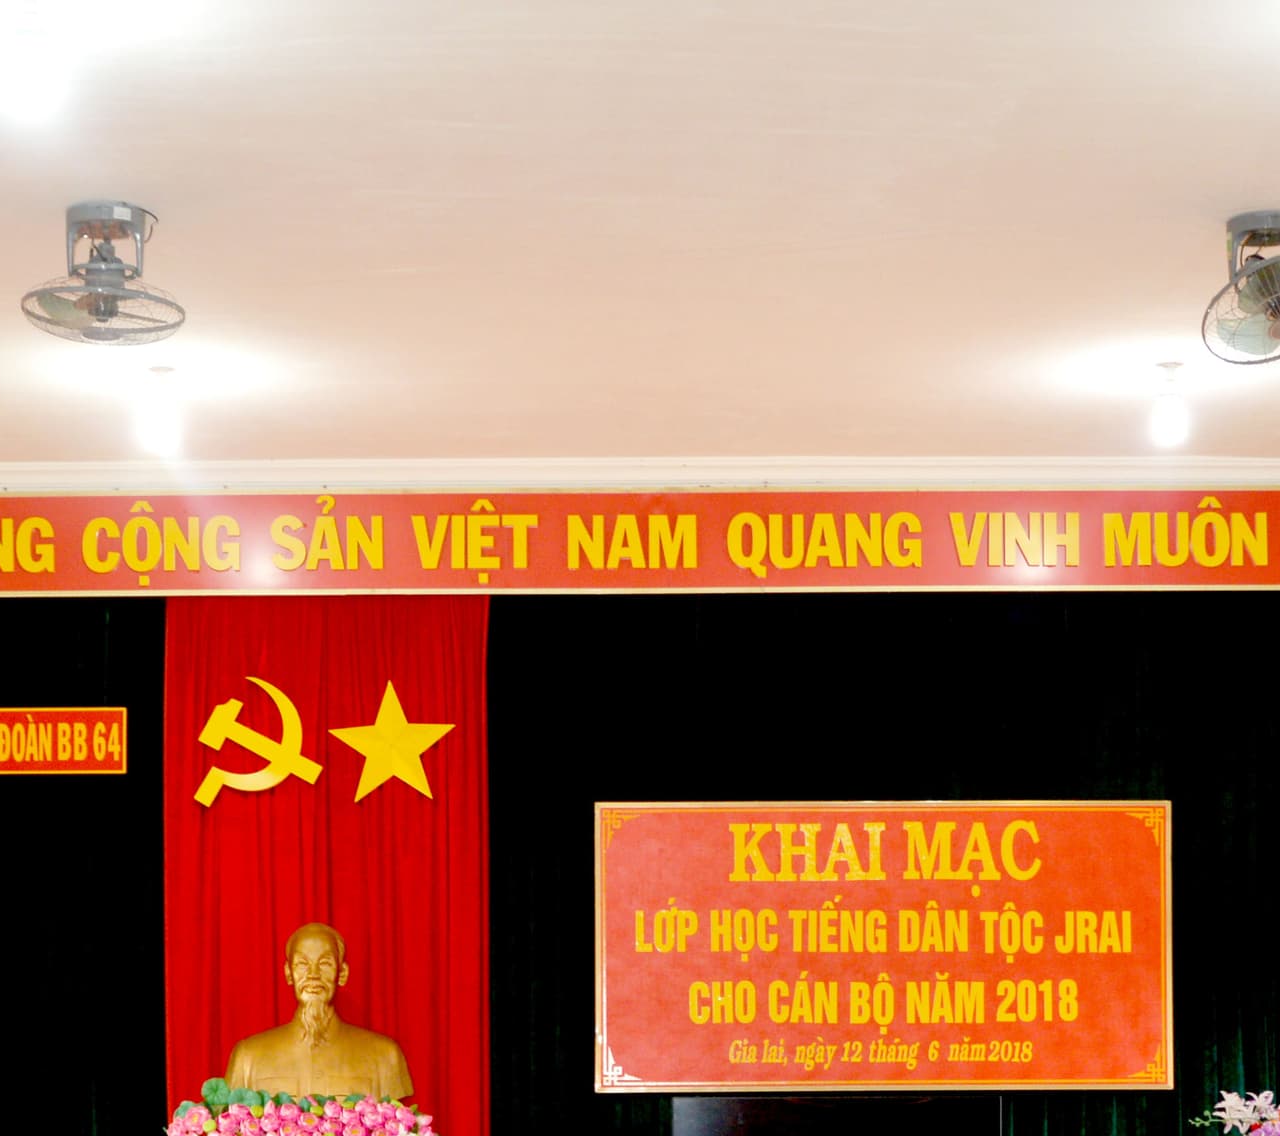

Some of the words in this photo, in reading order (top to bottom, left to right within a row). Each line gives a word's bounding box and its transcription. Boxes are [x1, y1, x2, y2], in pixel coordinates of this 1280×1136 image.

[82, 500, 241, 586] CỘNG
[271, 494, 384, 571] SẢN
[411, 498, 538, 584] VIỆT
[566, 511, 697, 569] NAM
[726, 511, 922, 578] QUANG
[949, 511, 1080, 568] VINH
[1102, 496, 1268, 567] MUÔN
[57, 722, 88, 761] BB
[93, 722, 121, 761] 64
[728, 822, 886, 882] KHAI
[903, 819, 1042, 897] MẠC
[635, 897, 698, 953] LỚP
[710, 908, 778, 962] HỌC
[788, 895, 887, 953] TIẾNG
[898, 900, 968, 953] DÂN
[980, 902, 1043, 963] TỘC
[1055, 909, 1132, 954] JRAI
[688, 980, 756, 1024] CHO
[768, 971, 840, 1024] CÁN
[850, 973, 895, 1035] BỘ
[906, 971, 985, 1024] NĂM
[996, 978, 1079, 1023] 2018
[729, 1039, 757, 1064] Gia
[794, 1036, 837, 1070] ngày
[840, 1041, 863, 1063] 12
[869, 1037, 920, 1070] tháng
[928, 1041, 940, 1062] 6
[947, 1036, 986, 1062] năm
[987, 1041, 1033, 1063] 2018
